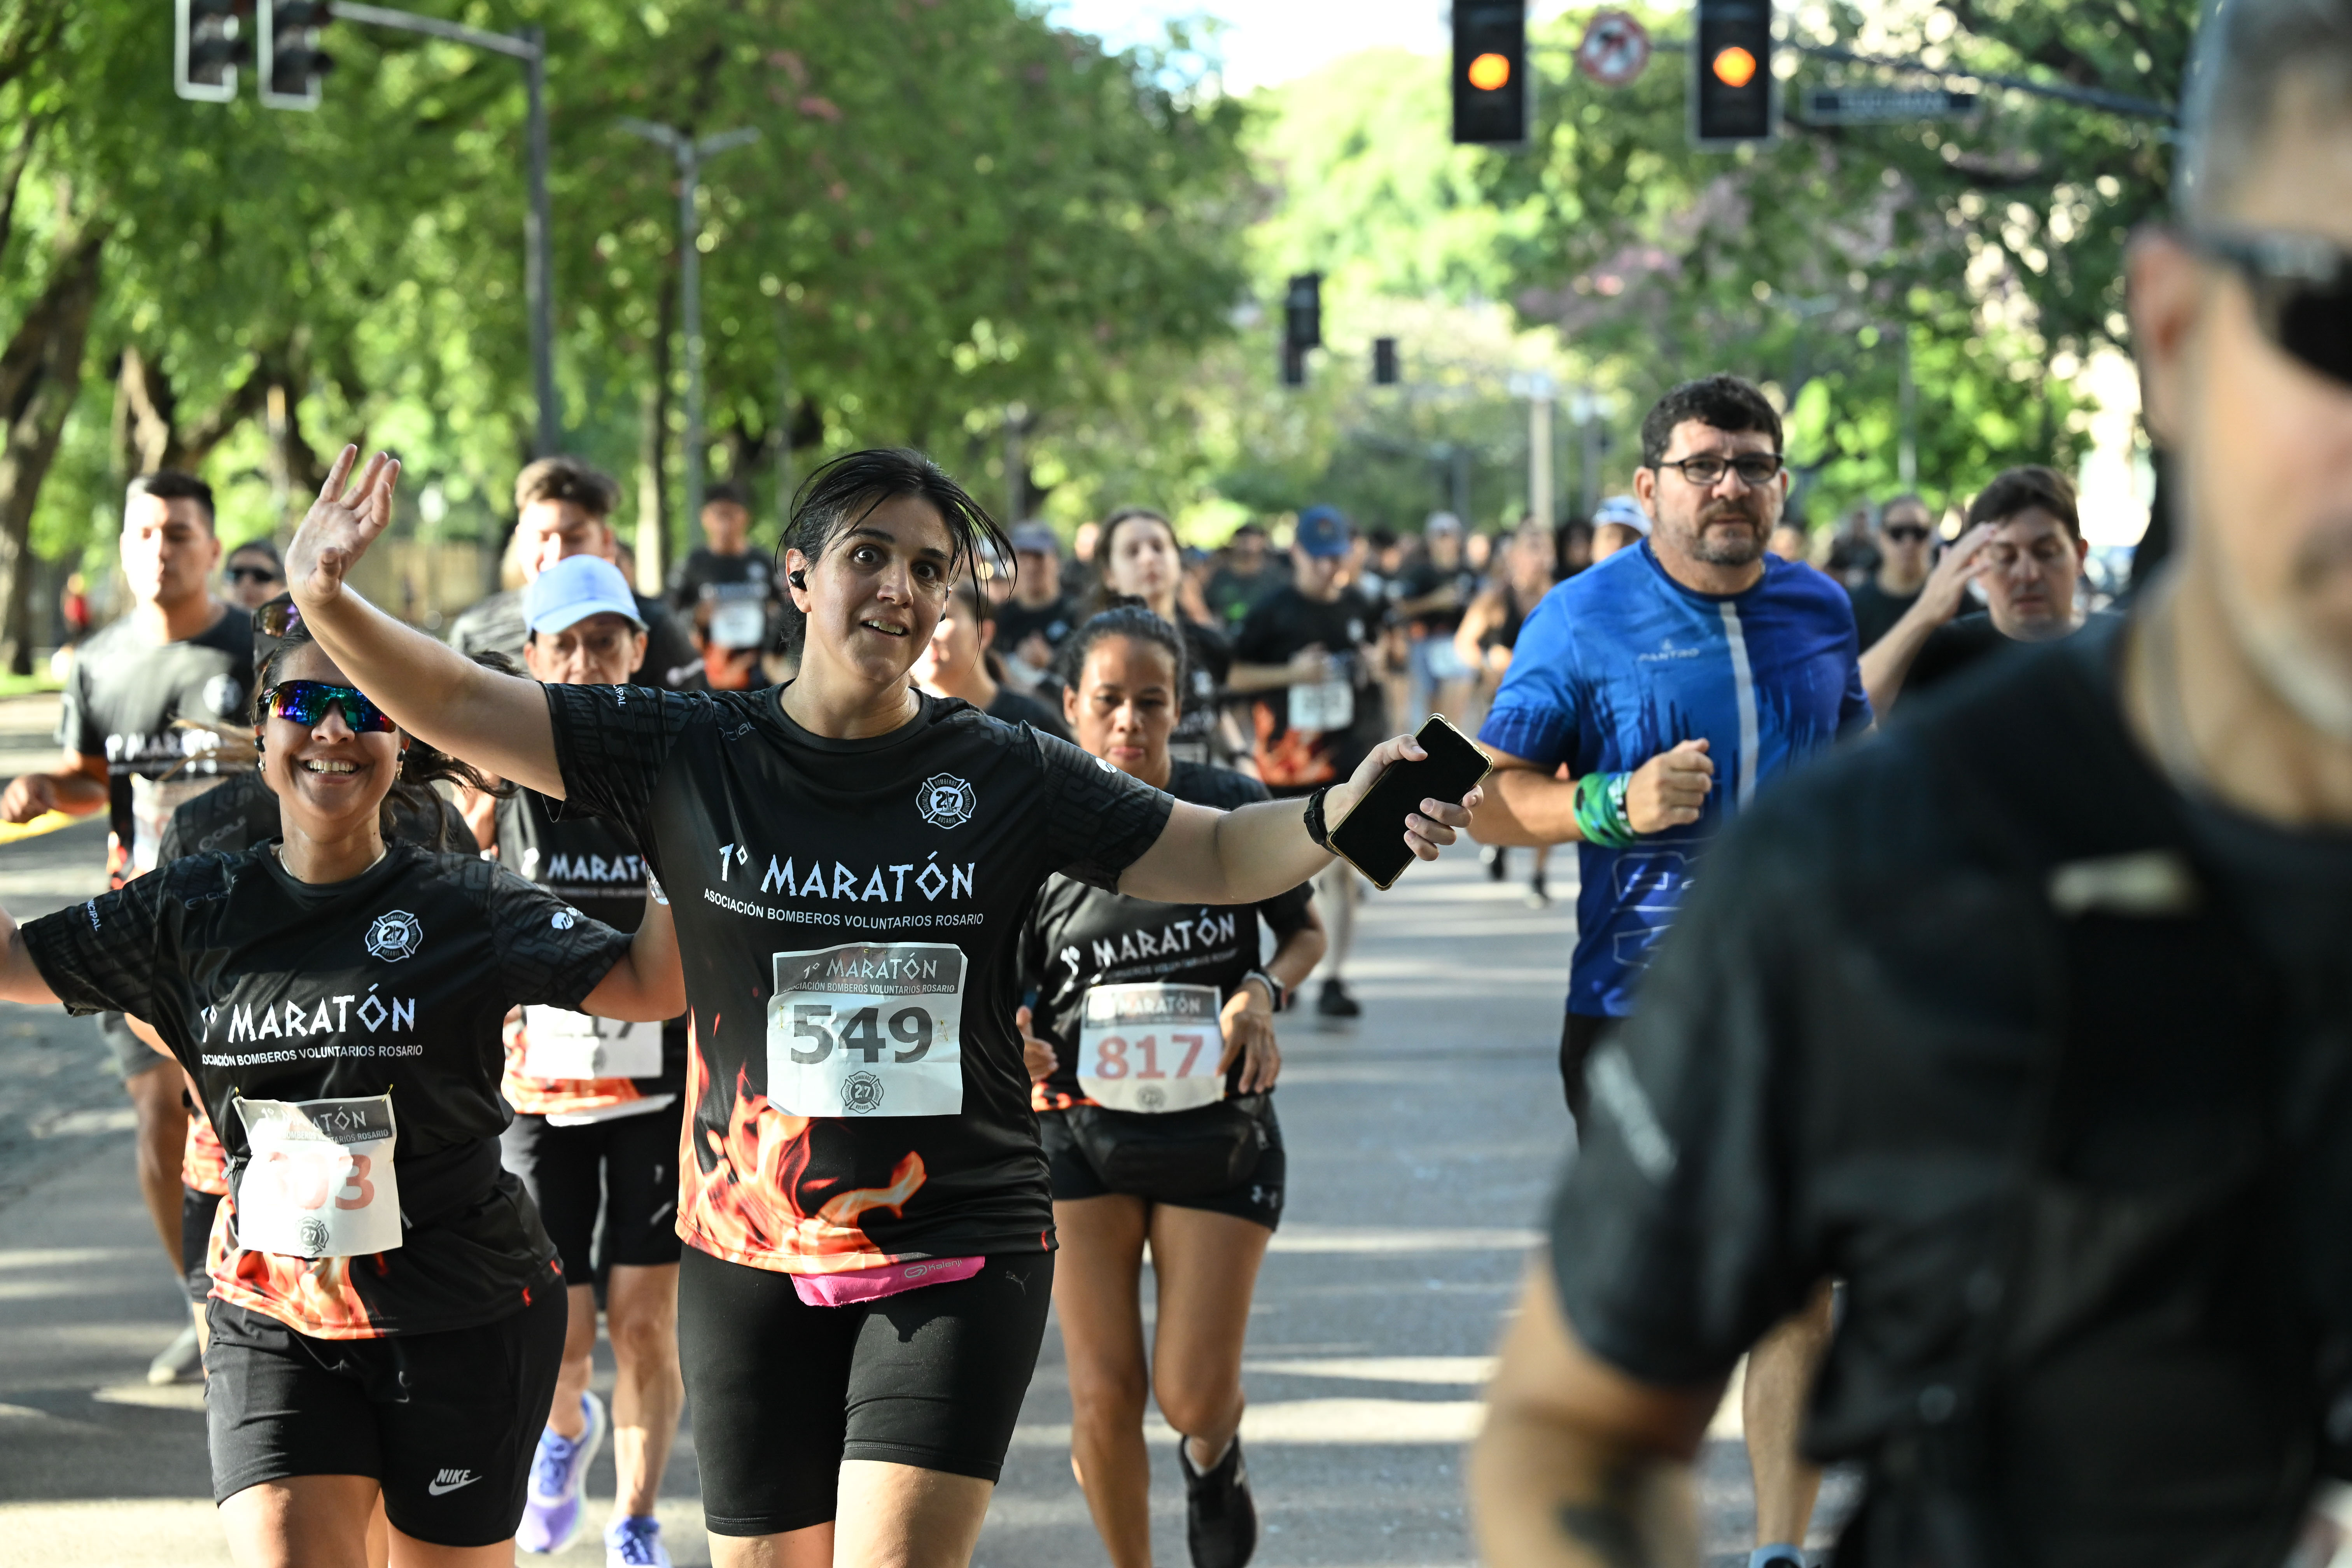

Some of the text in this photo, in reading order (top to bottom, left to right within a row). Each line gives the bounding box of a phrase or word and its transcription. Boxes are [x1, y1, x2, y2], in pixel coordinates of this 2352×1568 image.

[936, 791, 959, 808] 27
[547, 853, 647, 882] MARAT
[760, 850, 975, 902] MARATÓN
[704, 888, 984, 930] ASOCIACIÓN BOMBEROS VOLUNTARIOS ROSARIO
[382, 925, 405, 942] 27
[1092, 907, 1236, 968] MARATÓN
[826, 952, 937, 980] MARATÓN
[781, 980, 955, 994] ASOCIACIÓN BOMBEROS VOLUNTARIOS ROSARIO
[228, 983, 415, 1043] MARATÓN
[791, 1004, 933, 1064] 549
[237, 1050, 297, 1066] BOMBEROS
[298, 1045, 375, 1059] VOLUNTARIOS
[379, 1045, 423, 1057] ROSARIO
[1095, 1034, 1204, 1080] 817
[855, 1084, 871, 1098] 27
[357, 1129, 388, 1141] ROSARIO
[303, 1228, 317, 1242] 27
[928, 1258, 962, 1271] Kalenji
[436, 1468, 471, 1484] NIKE
